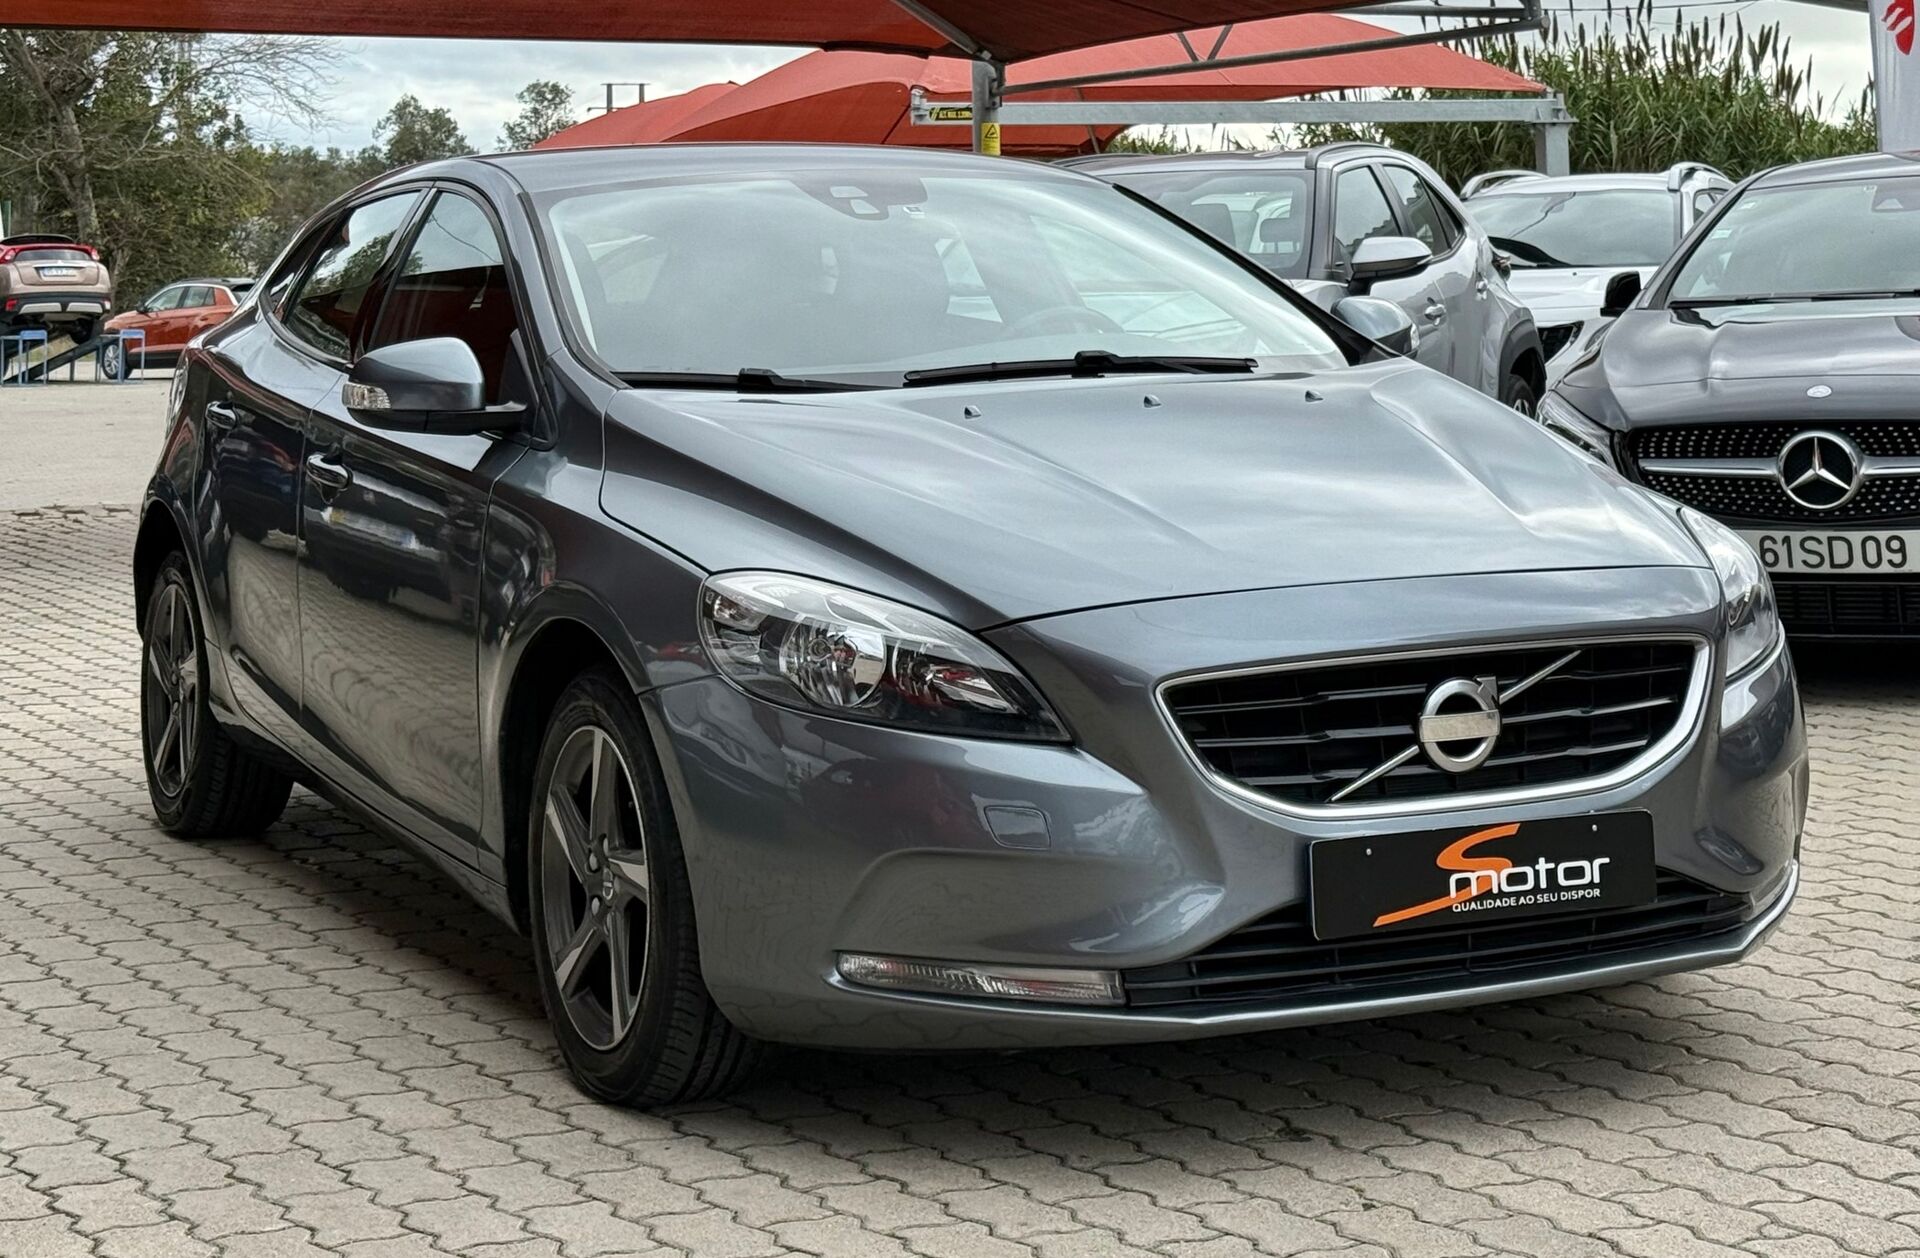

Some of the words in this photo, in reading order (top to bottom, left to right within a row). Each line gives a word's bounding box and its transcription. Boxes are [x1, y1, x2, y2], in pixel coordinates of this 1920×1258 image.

[1449, 857, 1611, 898] motor
[1452, 896, 1517, 912] QUALIDADE
[1518, 895, 1535, 905] AO
[1536, 892, 1558, 904] SEU
[1560, 888, 1601, 901] DISPOR
